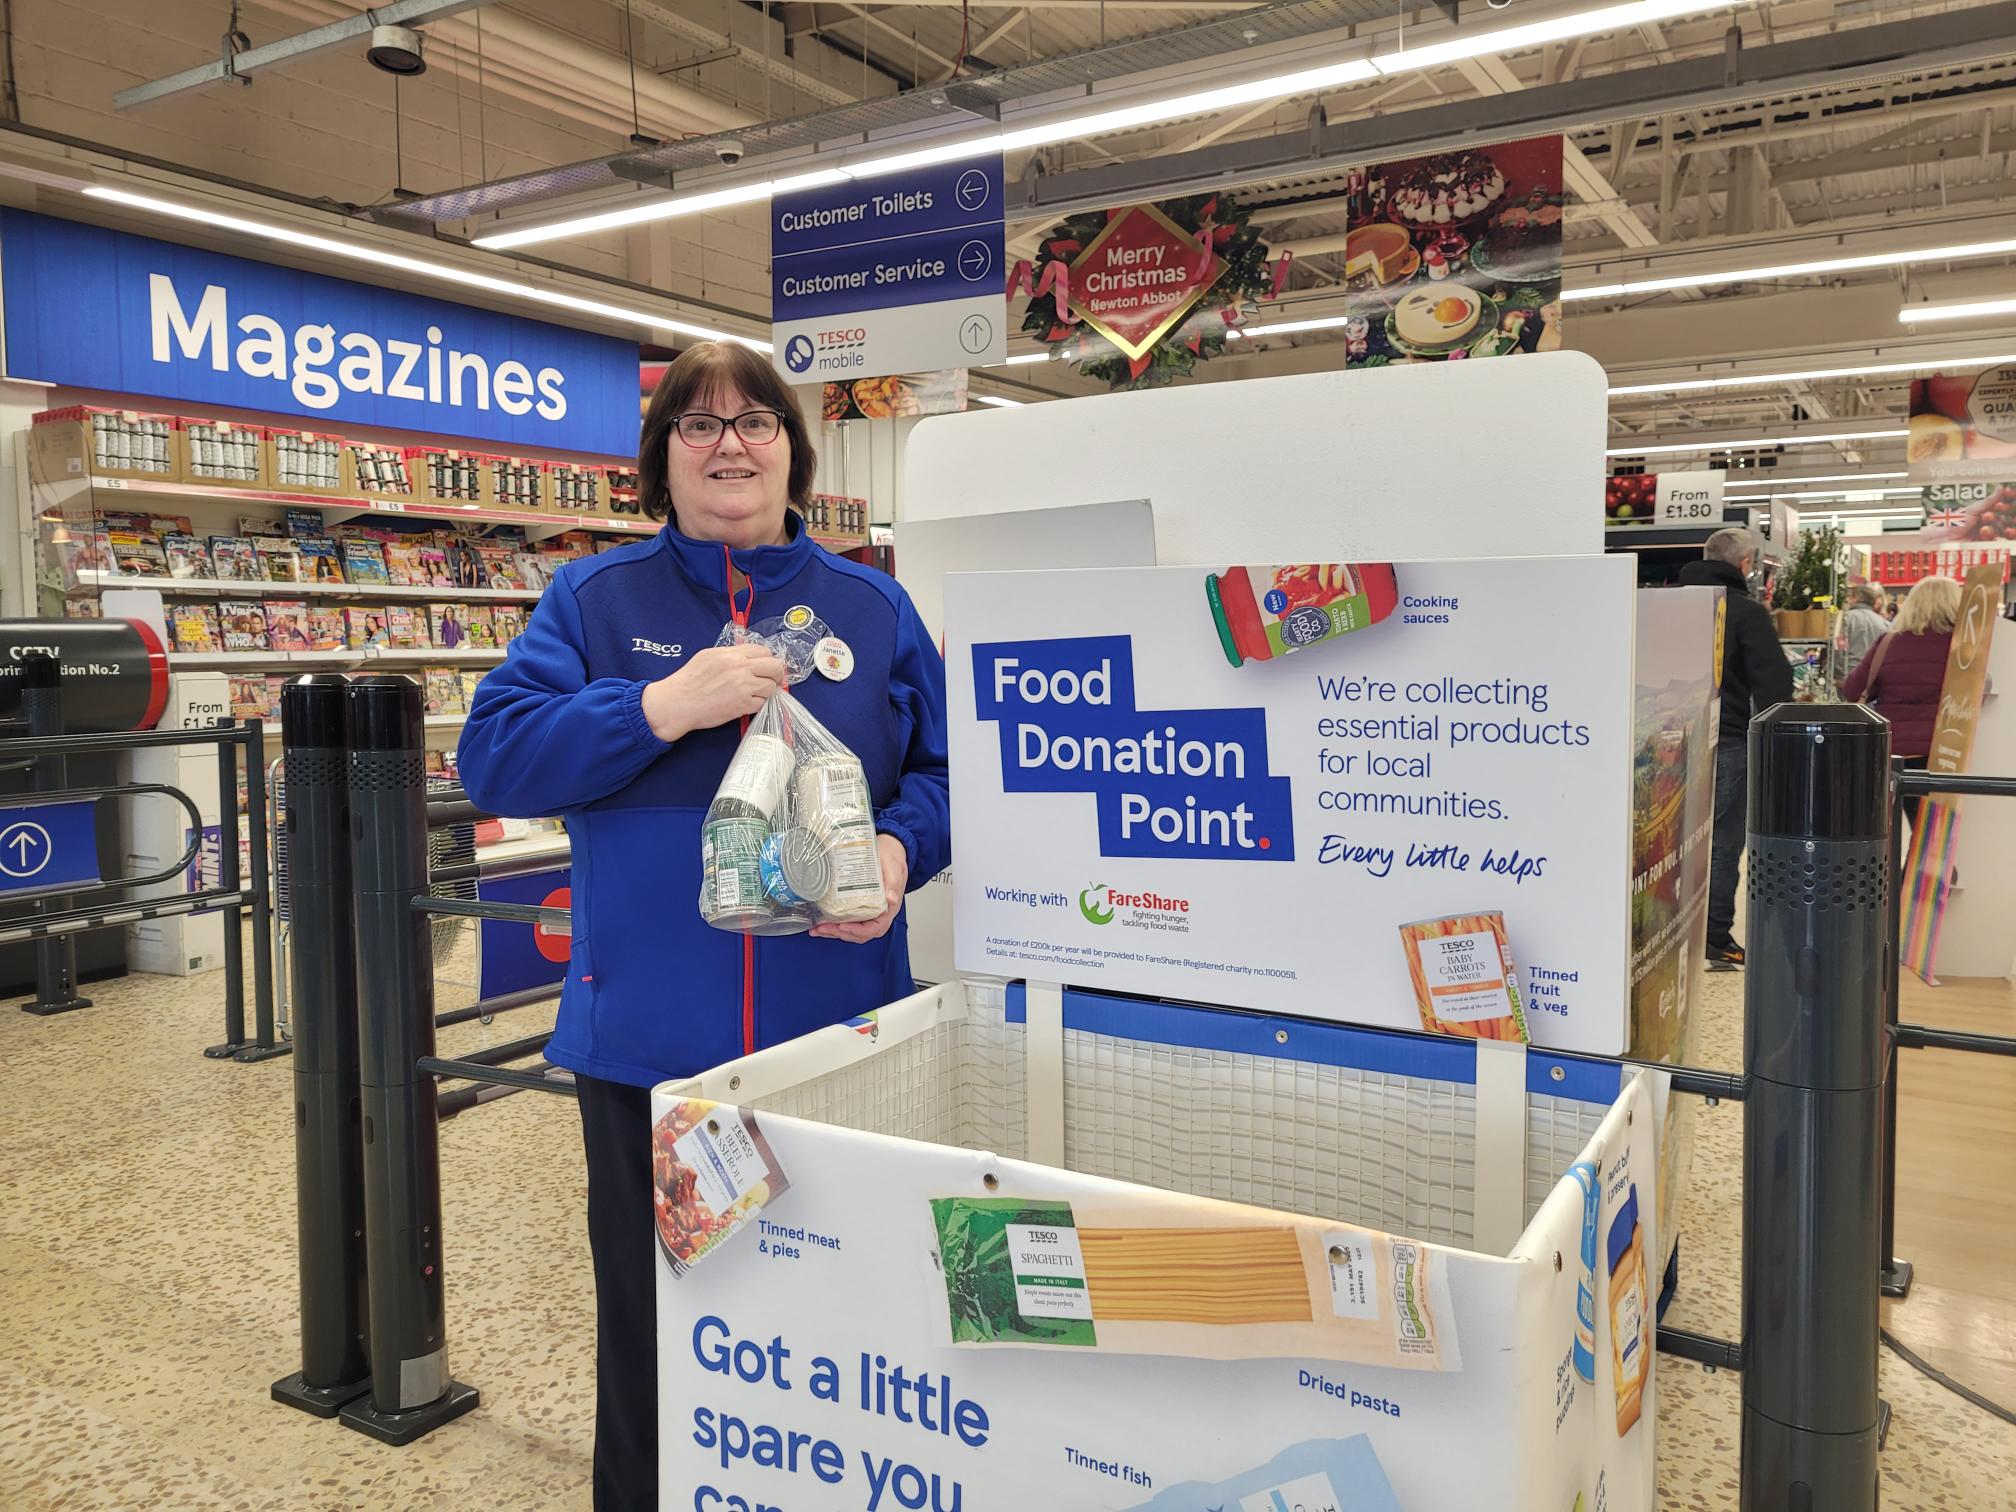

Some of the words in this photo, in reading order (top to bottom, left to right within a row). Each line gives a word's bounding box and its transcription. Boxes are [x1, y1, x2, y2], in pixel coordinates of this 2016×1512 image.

[780, 203, 867, 233] Customer
[872, 189, 933, 217] Toilets
[1106, 244, 1165, 268] Merry
[782, 268, 870, 298] Customer
[875, 257, 945, 284] Service
[1086, 263, 1187, 294] Christmas
[1090, 295, 1138, 312] Newton
[1141, 290, 1182, 307] Abbot
[149, 273, 568, 421] Magazines
[818, 328, 866, 345] TESCO
[819, 351, 865, 371] mobile
[1984, 402, 2016, 414] QUA
[1671, 488, 1709, 502] From
[1930, 482, 1987, 501] Salad
[1665, 503, 1712, 519] £1.80
[1403, 595, 1458, 610] Cooking
[1403, 612, 1449, 624] sauces
[1297, 615, 1315, 644] FOOD
[632, 638, 682, 655] TESCO
[89, 663, 120, 675] No.2
[993, 658, 1112, 705] Food
[1318, 675, 1396, 702] We’re
[1405, 677, 1548, 712] collecting
[189, 702, 223, 714] From
[1318, 714, 1438, 741] essential
[1450, 717, 1590, 748] products
[1017, 723, 1245, 779] Donation
[1318, 748, 1357, 775] for
[1367, 750, 1431, 778] local
[1318, 789, 1509, 820] communities.
[1120, 793, 1271, 850] Point.
[1318, 834, 1395, 877] Every
[1405, 843, 1469, 873] little
[1480, 848, 1548, 884] helps
[985, 886, 1037, 907] Working
[1039, 892, 1068, 907] with
[1108, 889, 1190, 913] FareShare
[1122, 919, 1149, 930] tackling
[1150, 921, 1167, 931] food
[1168, 924, 1190, 933] waste
[1132, 910, 1160, 922] fighting
[1161, 913, 1189, 925] hunger,
[1439, 939, 1474, 951] TESCO
[986, 947, 1008, 957] Details
[1009, 950, 1018, 958] at:
[1019, 951, 1105, 969] tesco.com/foodcollection
[992, 937, 1021, 947] donation
[1030, 941, 1050, 950] £200k
[1051, 944, 1063, 953] per
[1064, 946, 1079, 954] year
[1081, 947, 1092, 955] will
[1092, 948, 1103, 957] be
[1103, 951, 1135, 962] provided
[1136, 954, 1144, 962] to
[1145, 954, 1182, 966] FareShare
[1183, 958, 1225, 971] (Registered
[1225, 964, 1252, 976] charity
[1446, 953, 1473, 965] BABY
[1439, 961, 1486, 975] CARROTS
[1448, 974, 1456, 982] IN
[1457, 972, 1482, 981] WATER
[1529, 966, 1579, 982] Tinned
[1529, 982, 1561, 997] fruit
[1529, 998, 1539, 1010] &
[1544, 1003, 1568, 1016] veg
[734, 1121, 754, 1158] TESCO
[714, 1133, 745, 1186] ASSEROLE
[758, 1219, 805, 1241] Tinned
[808, 1230, 841, 1250] meat
[1028, 1231, 1058, 1240] TESCO
[759, 1239, 769, 1253] &
[773, 1242, 800, 1258] pies
[1021, 1252, 1073, 1267] SPAGHETTI
[692, 1315, 792, 1391] Got
[809, 1356, 840, 1403] a
[861, 1352, 990, 1447] little
[1299, 1369, 1346, 1400] Dried
[1351, 1390, 1400, 1418] pasta
[692, 1406, 845, 1484] spare
[860, 1450, 962, 1512] you
[1064, 1447, 1118, 1477] Tinned
[1122, 1466, 1152, 1488] fish
